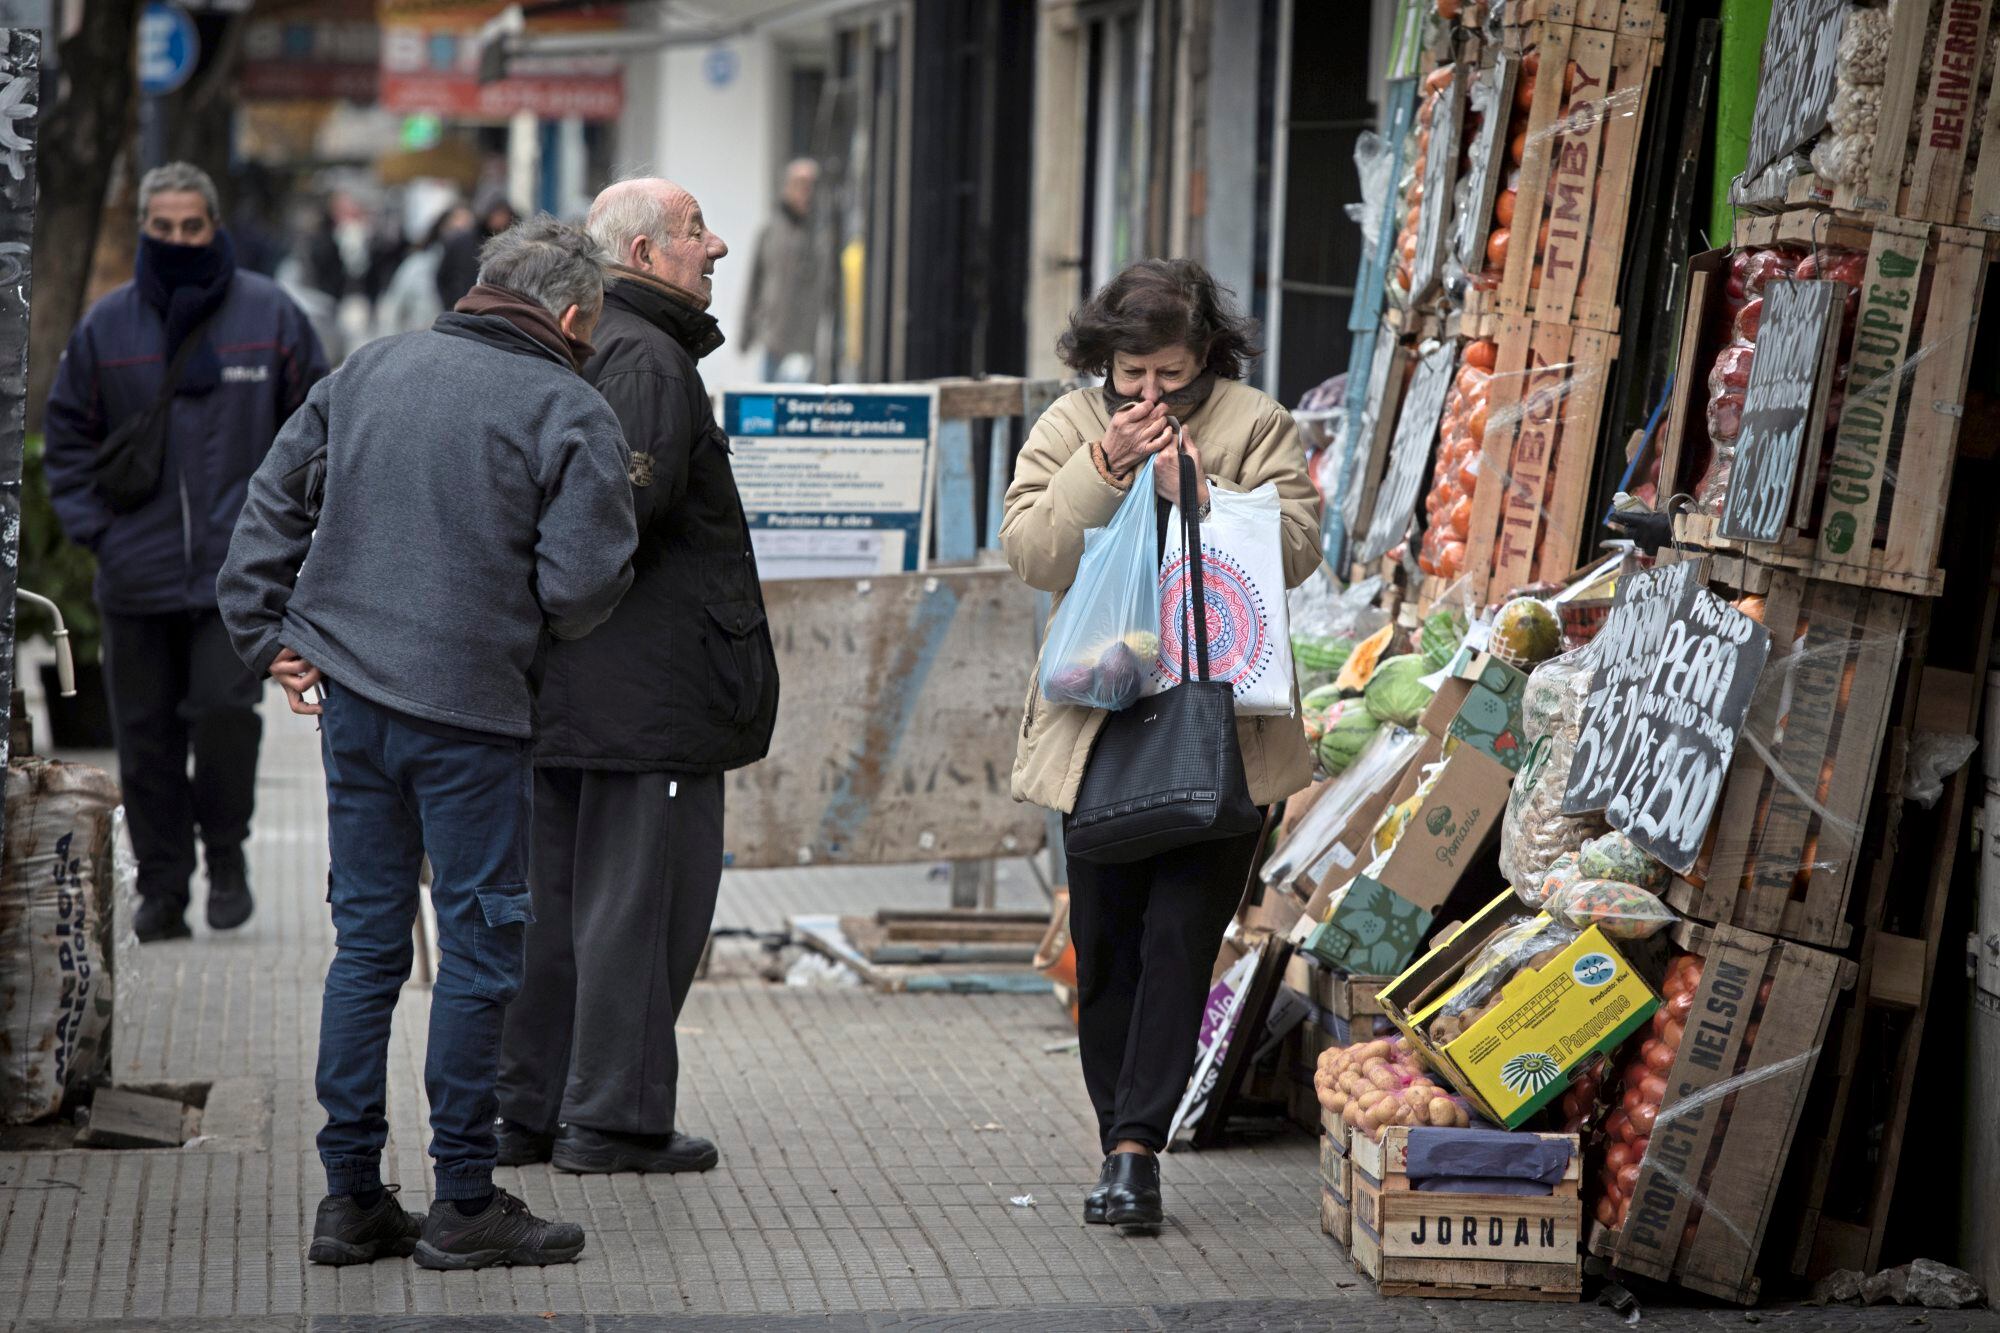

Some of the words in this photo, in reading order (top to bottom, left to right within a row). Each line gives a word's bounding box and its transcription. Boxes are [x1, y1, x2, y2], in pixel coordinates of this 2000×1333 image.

[1546, 63, 1601, 280] TIMBOY
[786, 399, 854, 415] Servicio
[786, 418, 808, 433] de
[810, 418, 906, 435] Emergencia
[1830, 284, 1910, 505] GUADALUPE
[1501, 352, 1560, 568] TIMBOY
[767, 515, 820, 527] Permiso
[823, 515, 839, 527] de
[842, 515, 873, 527] obra
[1648, 619, 1739, 716] PERA
[1589, 982, 1617, 1005] Producto:
[1689, 961, 1751, 1071] NELSON
[1546, 1044, 1566, 1065] El
[1559, 994, 1631, 1055] Panqueque
[1410, 1215, 1555, 1248] JORDAN
